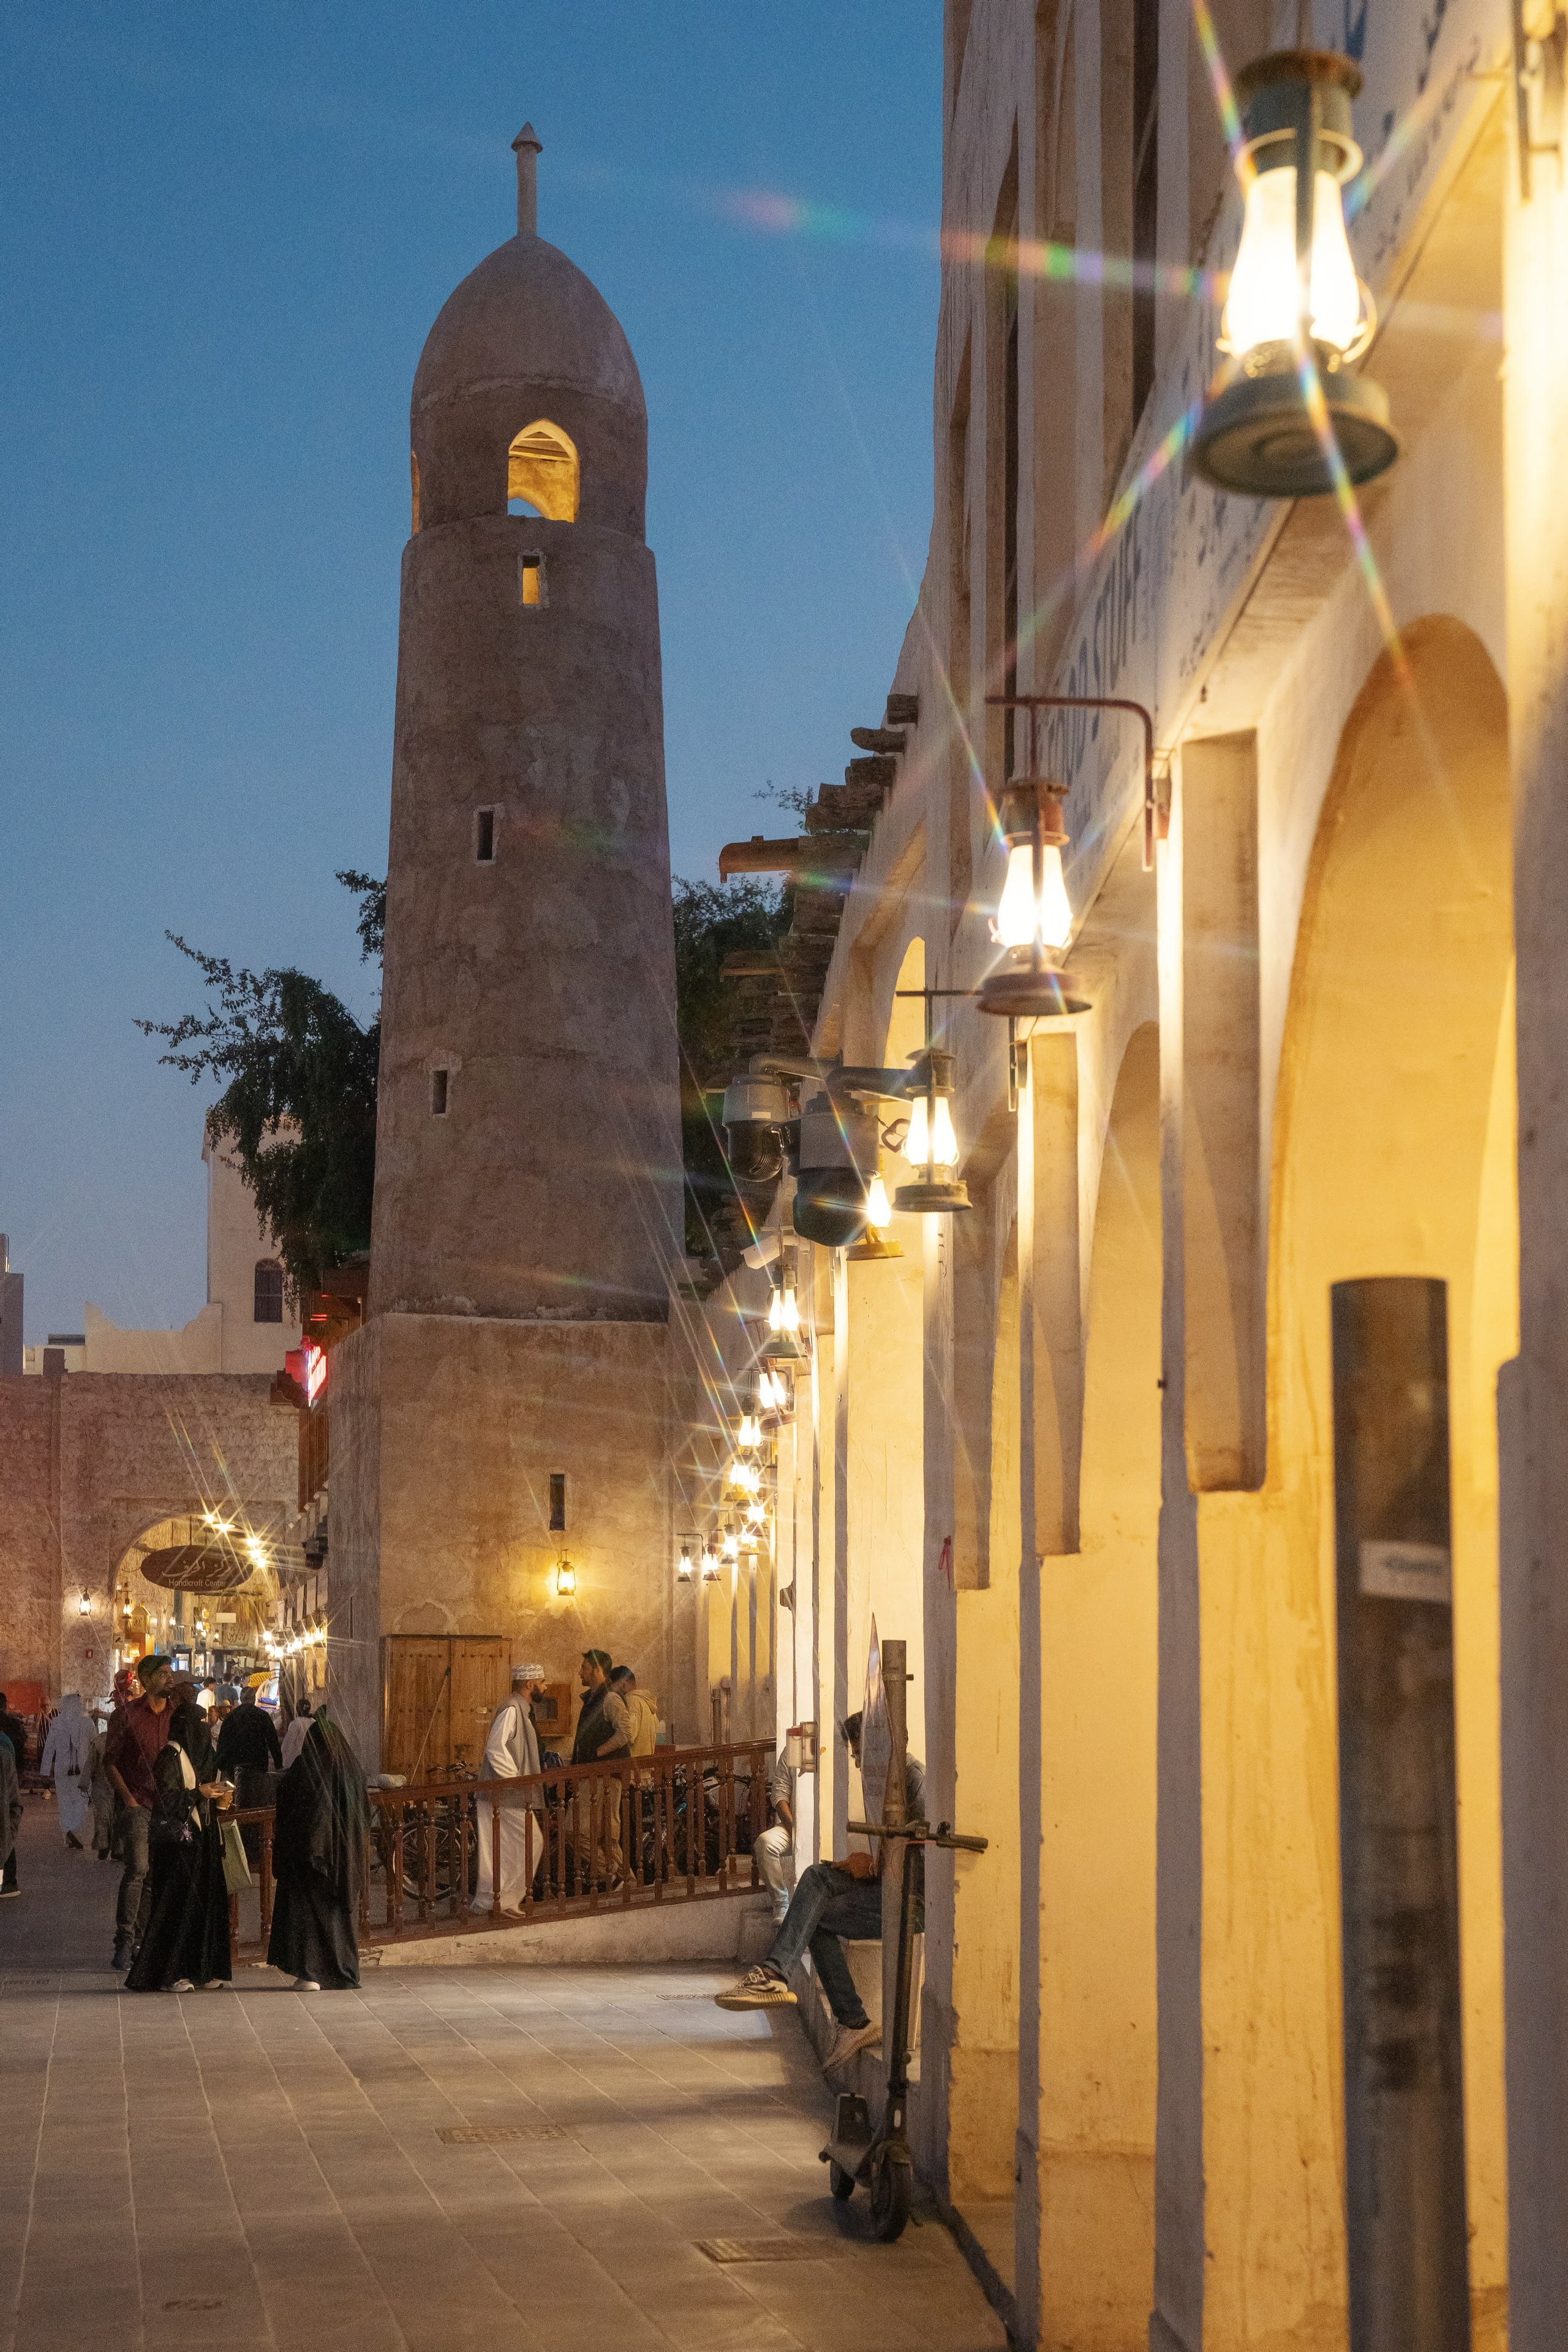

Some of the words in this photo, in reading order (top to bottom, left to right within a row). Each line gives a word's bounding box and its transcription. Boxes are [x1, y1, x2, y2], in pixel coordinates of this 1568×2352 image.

[1091, 497, 1142, 741] STUFF
[168, 1578, 204, 1587] Handicraft
[205, 1578, 227, 1587] Center
